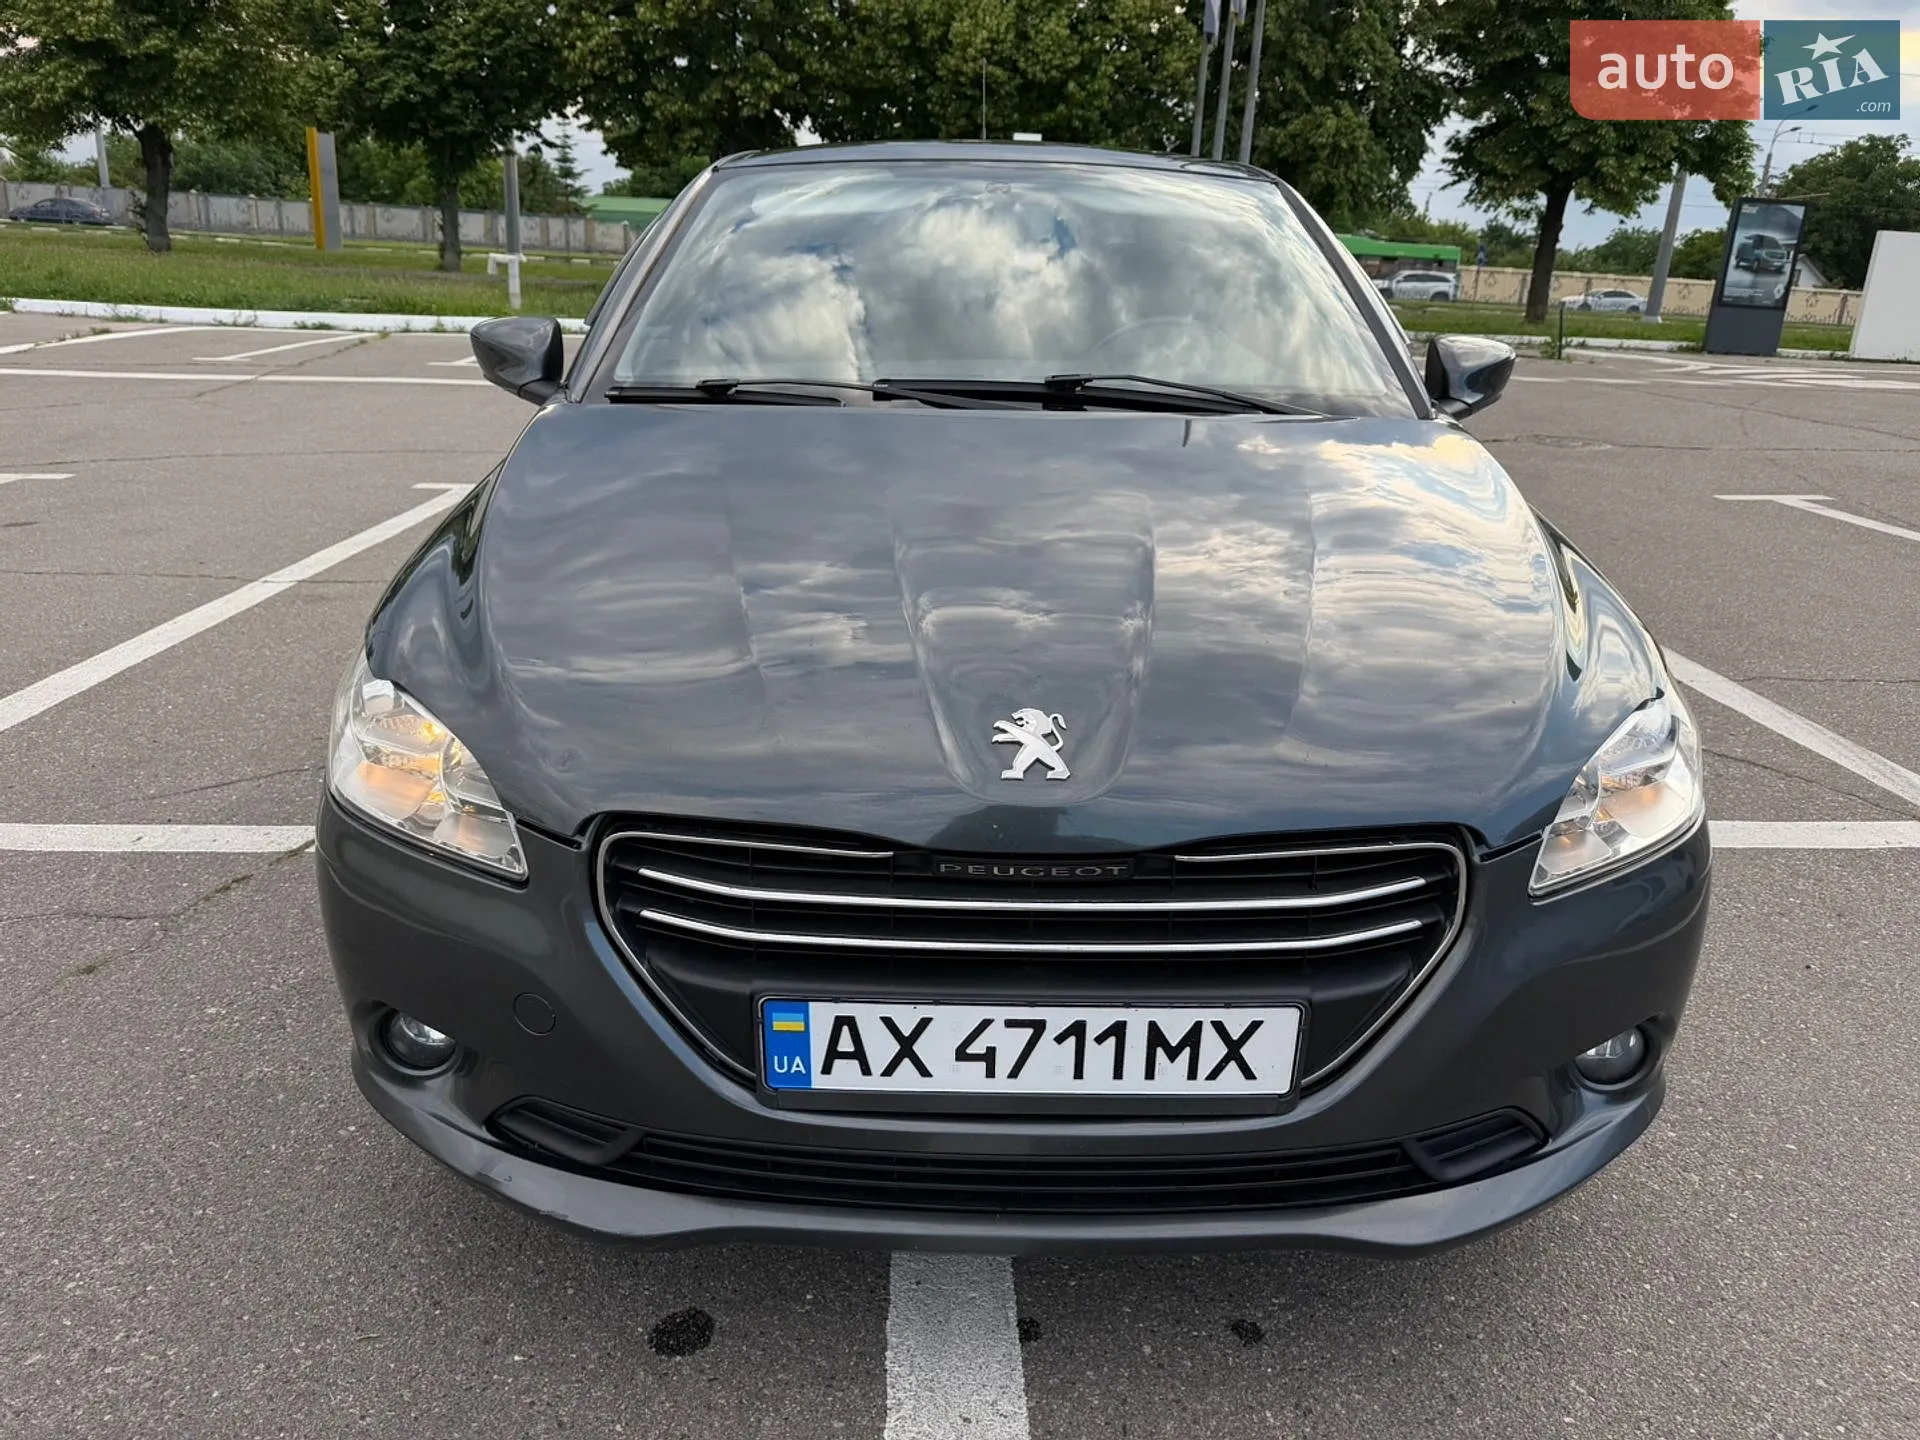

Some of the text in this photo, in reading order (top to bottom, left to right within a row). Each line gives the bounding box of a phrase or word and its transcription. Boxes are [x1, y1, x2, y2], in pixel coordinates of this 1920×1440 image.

[939, 863, 1128, 877] PEUGEOT
[820, 1015, 1264, 1081] AX 4711 MX
[773, 1055, 807, 1075] UA
